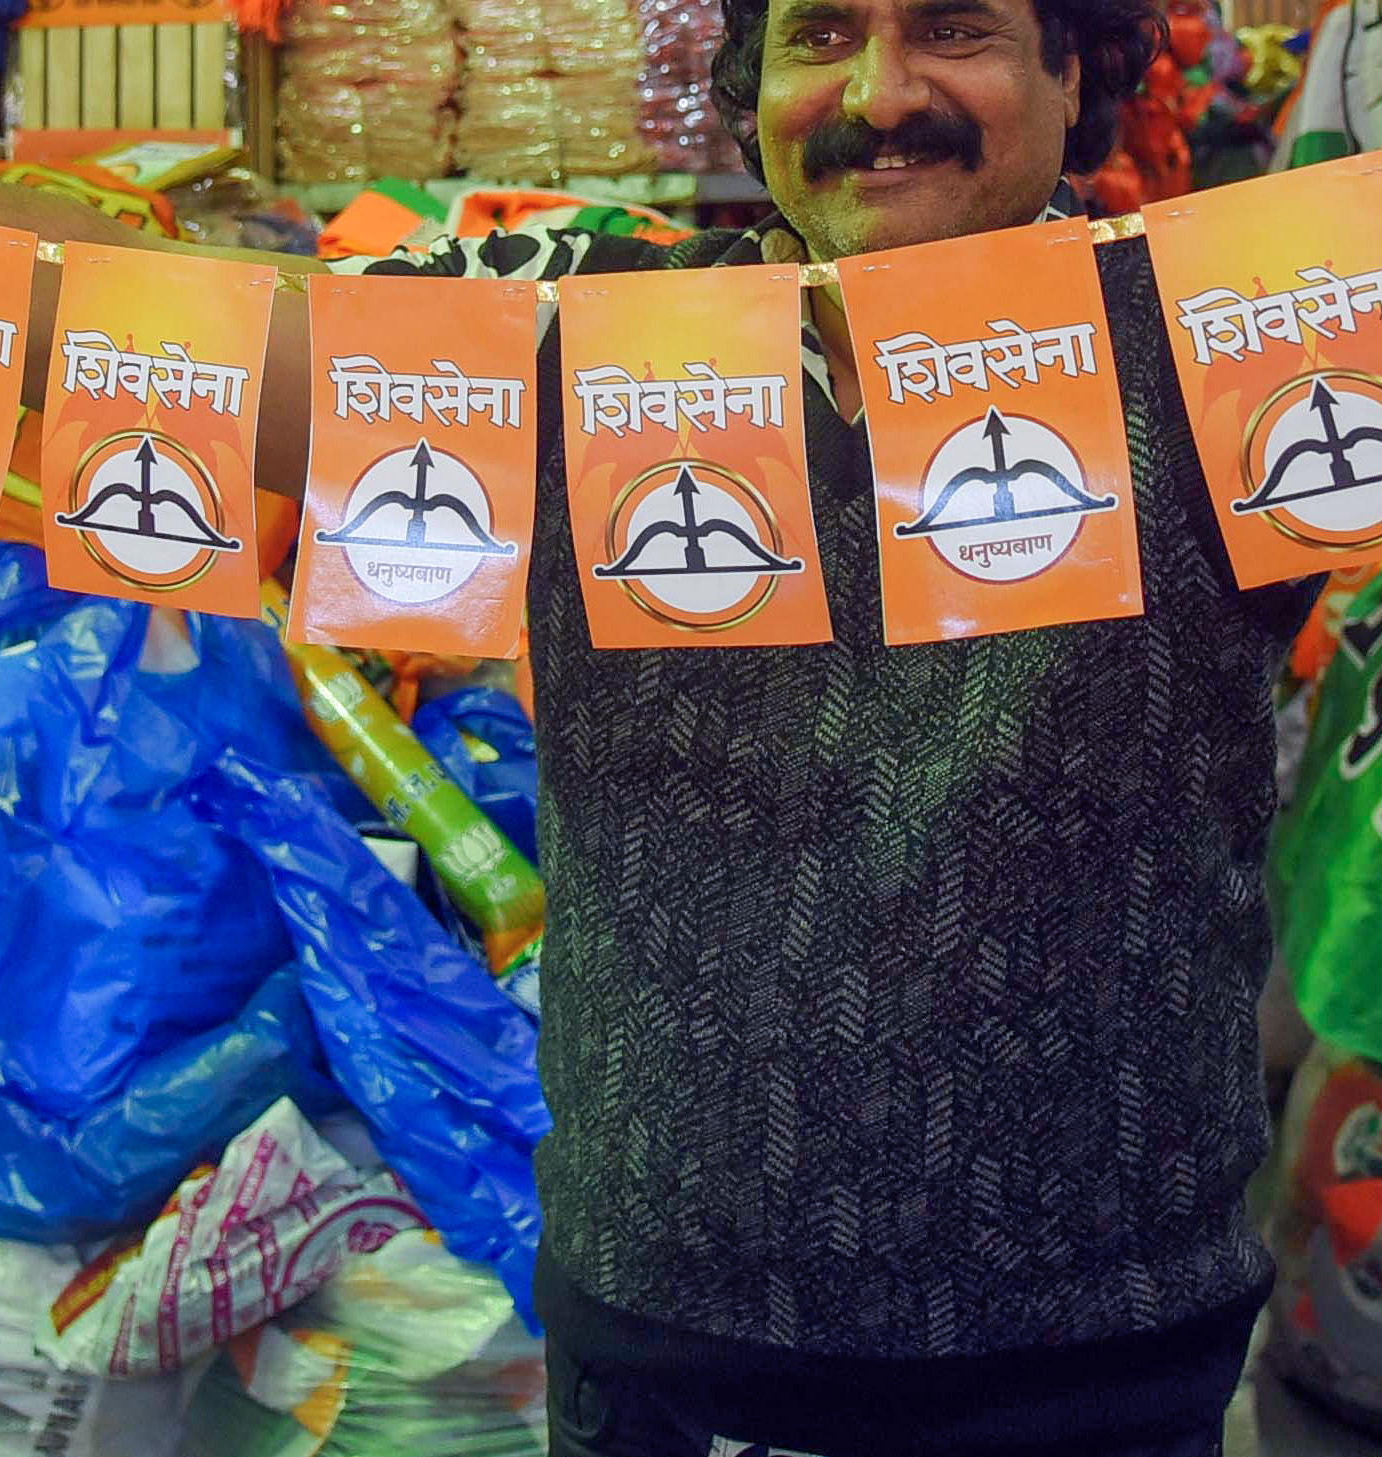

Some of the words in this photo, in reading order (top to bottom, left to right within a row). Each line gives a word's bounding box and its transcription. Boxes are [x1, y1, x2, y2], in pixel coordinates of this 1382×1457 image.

[62, 330, 248, 419] शिवसेना
[329, 355, 524, 430] शिवसेना
[876, 318, 1096, 405] शिवसेना
[575, 362, 787, 437] शिवसेना
[366, 561, 452, 588] धनुष्यबाण
[958, 533, 1053, 565] धनुष्यबाण
